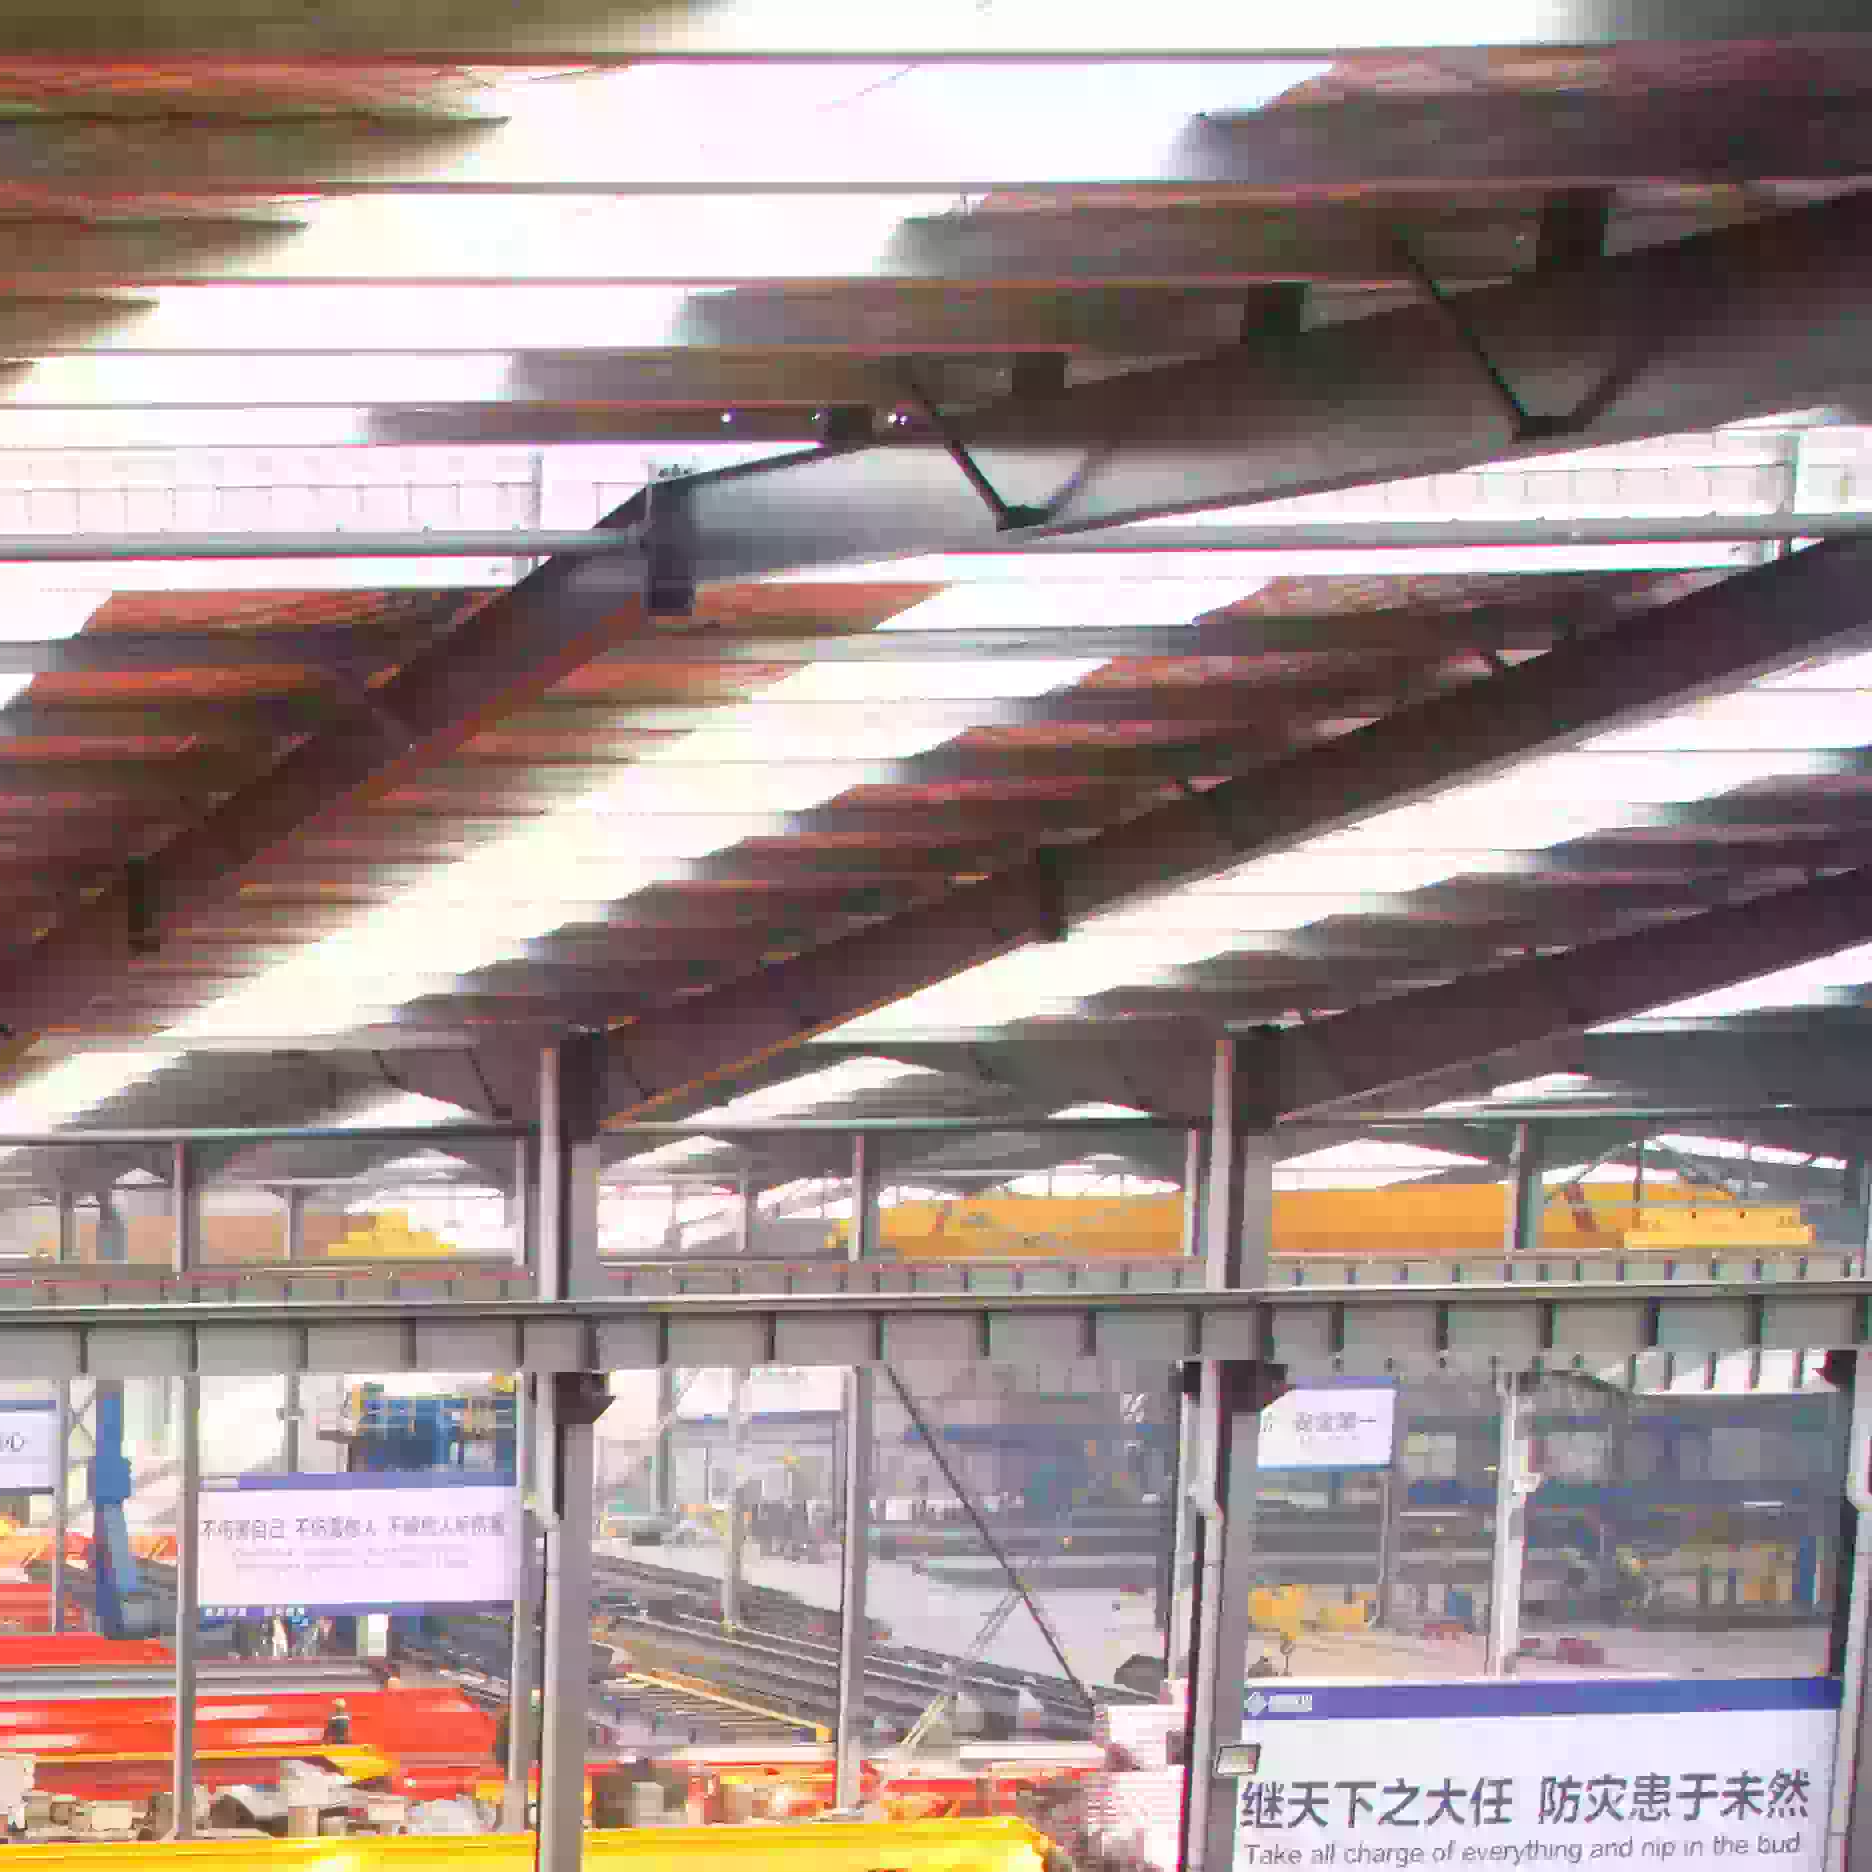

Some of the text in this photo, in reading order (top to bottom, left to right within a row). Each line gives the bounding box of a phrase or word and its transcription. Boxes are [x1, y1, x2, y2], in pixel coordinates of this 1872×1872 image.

[1240, 1767, 1812, 1829] 继天下之大任 防灾患于未然
[1244, 1832, 1801, 1869] Take all charge of everything and nip in the bud
